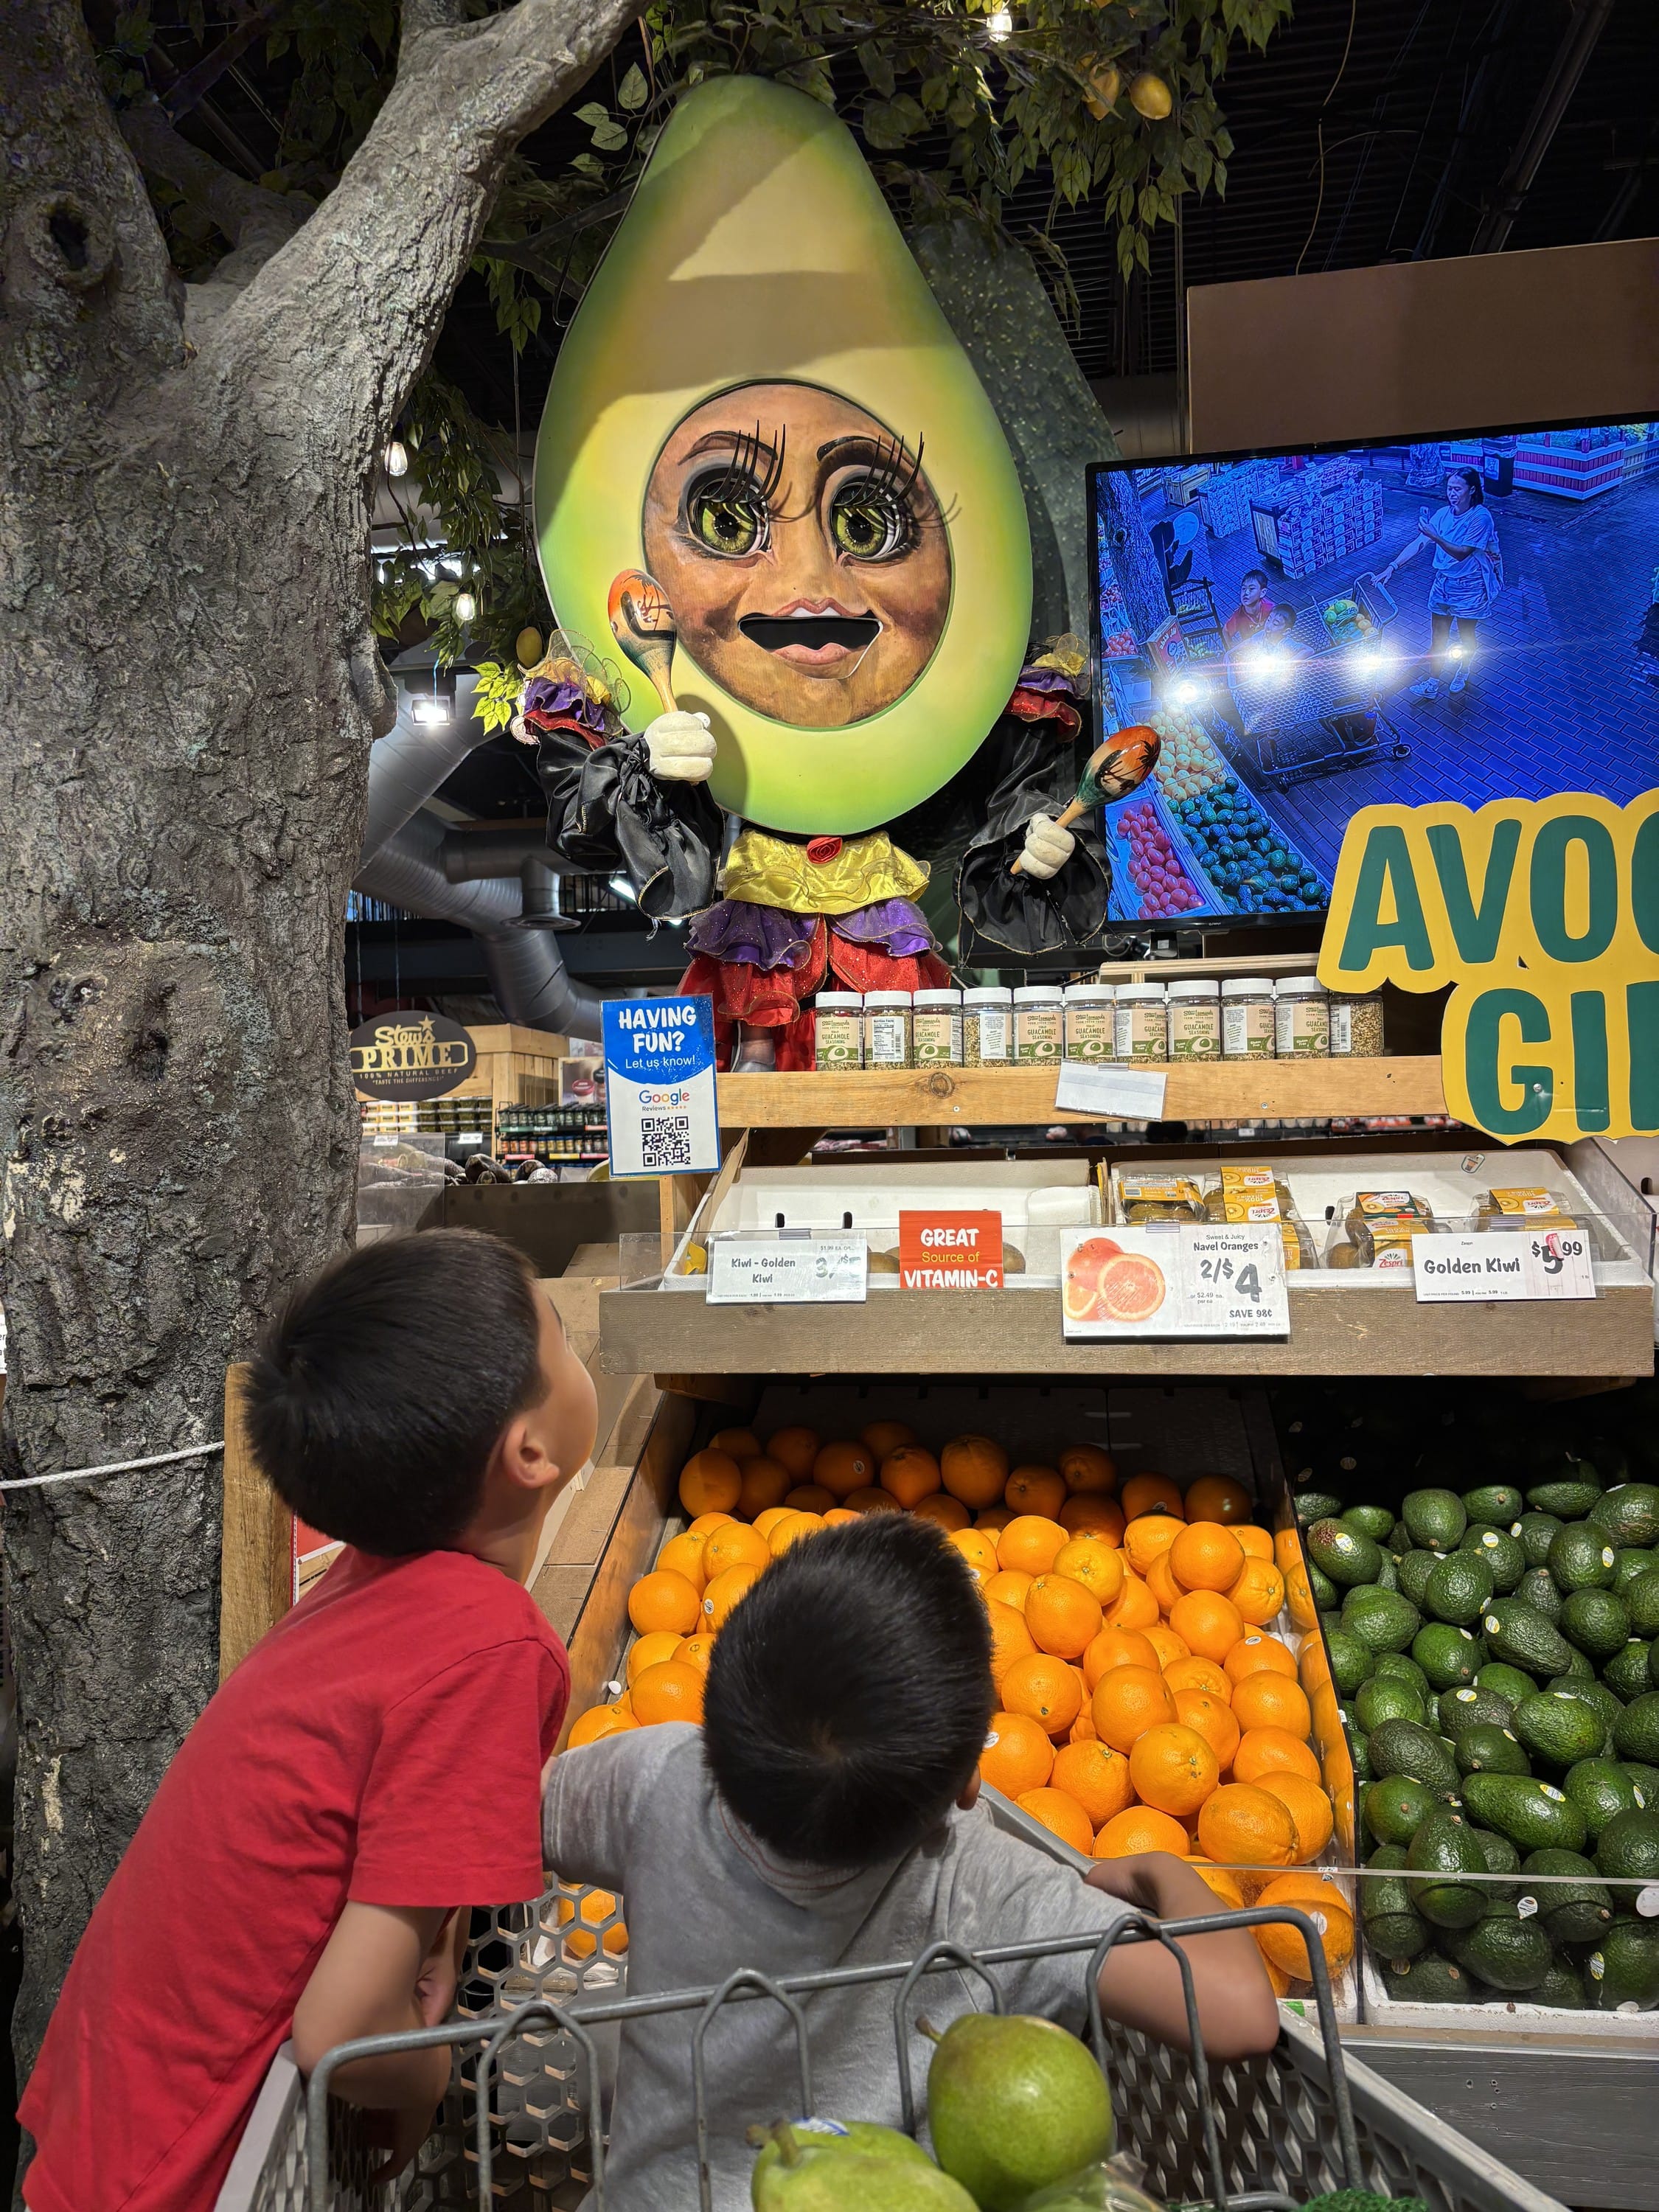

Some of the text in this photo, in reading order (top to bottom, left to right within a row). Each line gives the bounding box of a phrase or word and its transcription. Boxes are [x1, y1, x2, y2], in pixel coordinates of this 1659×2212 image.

[619, 1005, 696, 1029] HAVING
[633, 1031, 685, 1054] FUN?
[361, 1043, 452, 1069] PRIME
[625, 1054, 695, 1068] Let us know!
[639, 1088, 690, 1105] Google
[920, 1228, 979, 1248] GREAT
[1193, 1241, 1259, 1252] Navel Oranges
[731, 1258, 751, 1267] Kiwi
[761, 1258, 796, 1267] Golden
[922, 1251, 980, 1263] Source of
[1379, 1259, 1403, 1268] Zespri
[1424, 1257, 1520, 1274] Golden Kiwi
[752, 1273, 773, 1283] Kiwi
[904, 1269, 998, 1288] VITAMIN-C
[1229, 1309, 1273, 1318] SAVE 98¢
